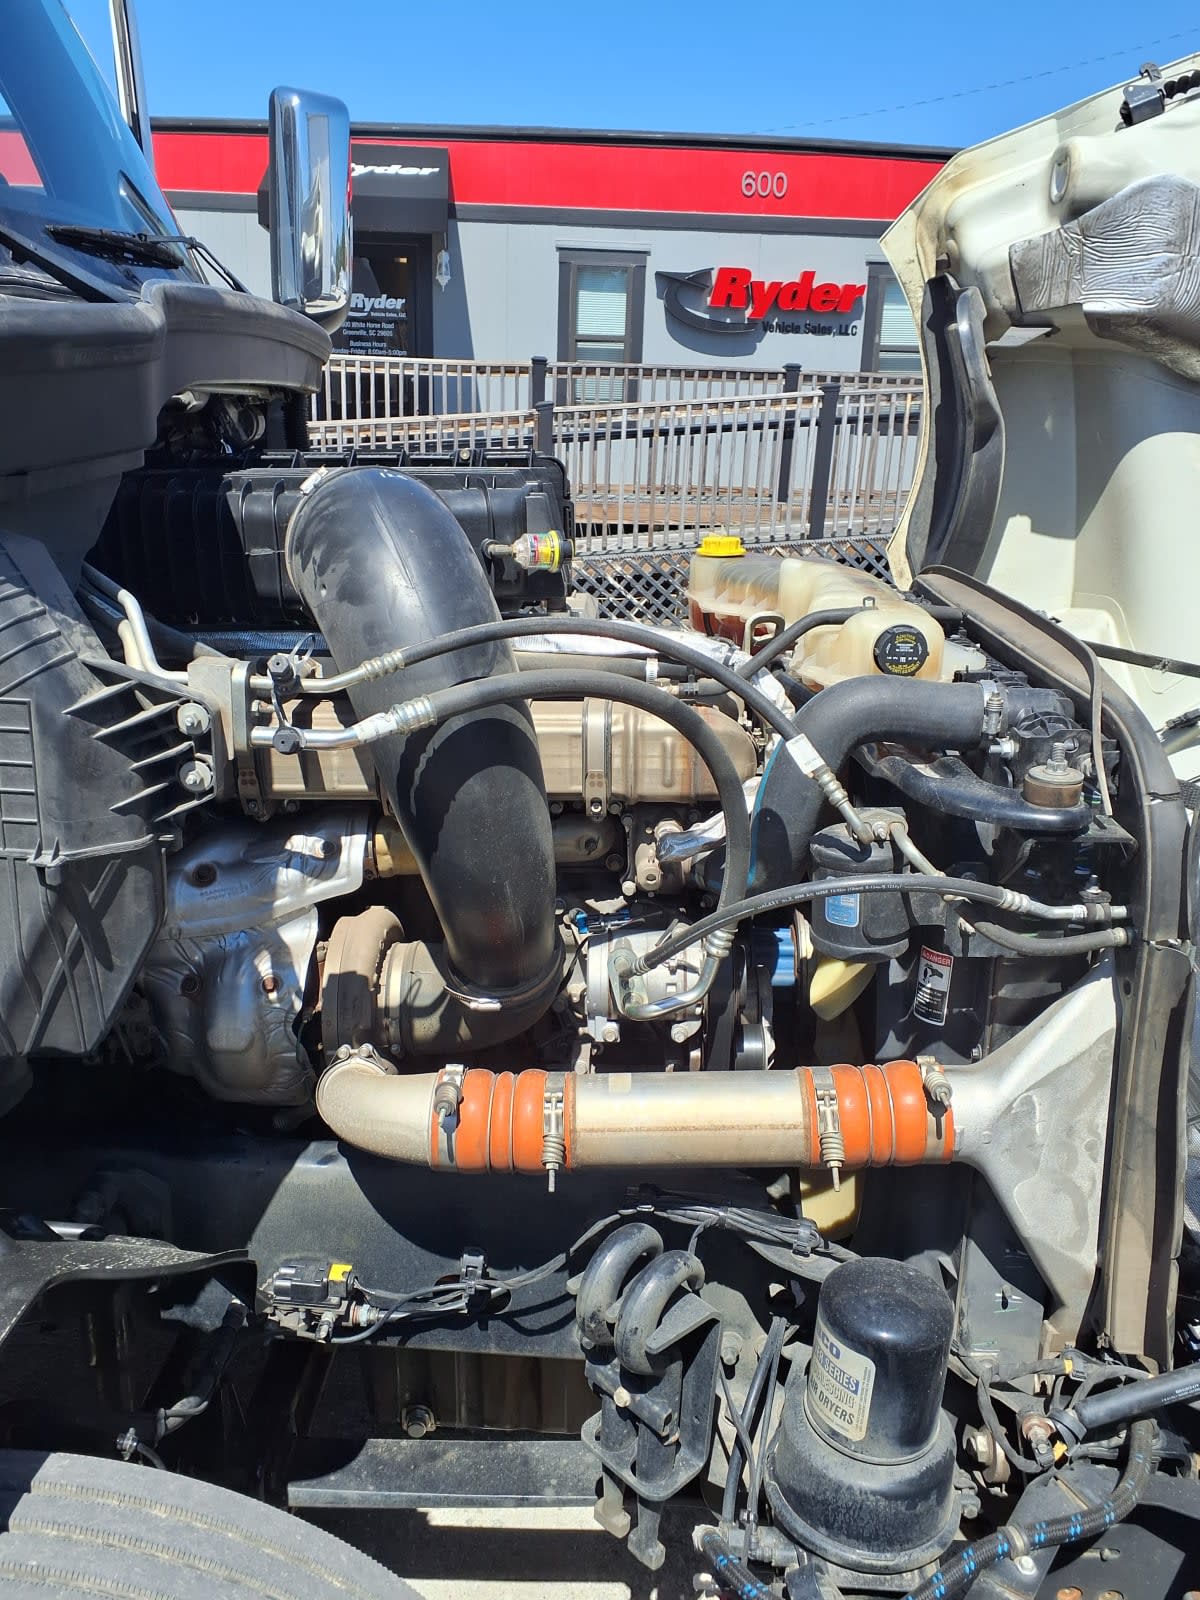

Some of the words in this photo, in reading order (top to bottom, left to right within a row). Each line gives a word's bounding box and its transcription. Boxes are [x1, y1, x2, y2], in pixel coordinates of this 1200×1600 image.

[351, 162, 440, 176] yder
[742, 171, 788, 198] 600
[350, 293, 406, 311] Ryder
[708, 267, 866, 320] Ryder
[762, 321, 801, 335] Vehicle
[804, 322, 836, 337] Sales,
[838, 324, 858, 336] LLC
[926, 952, 951, 965] DANGER
[824, 1358, 857, 1392] SERIES
[818, 1390, 855, 1425] DRYERS
